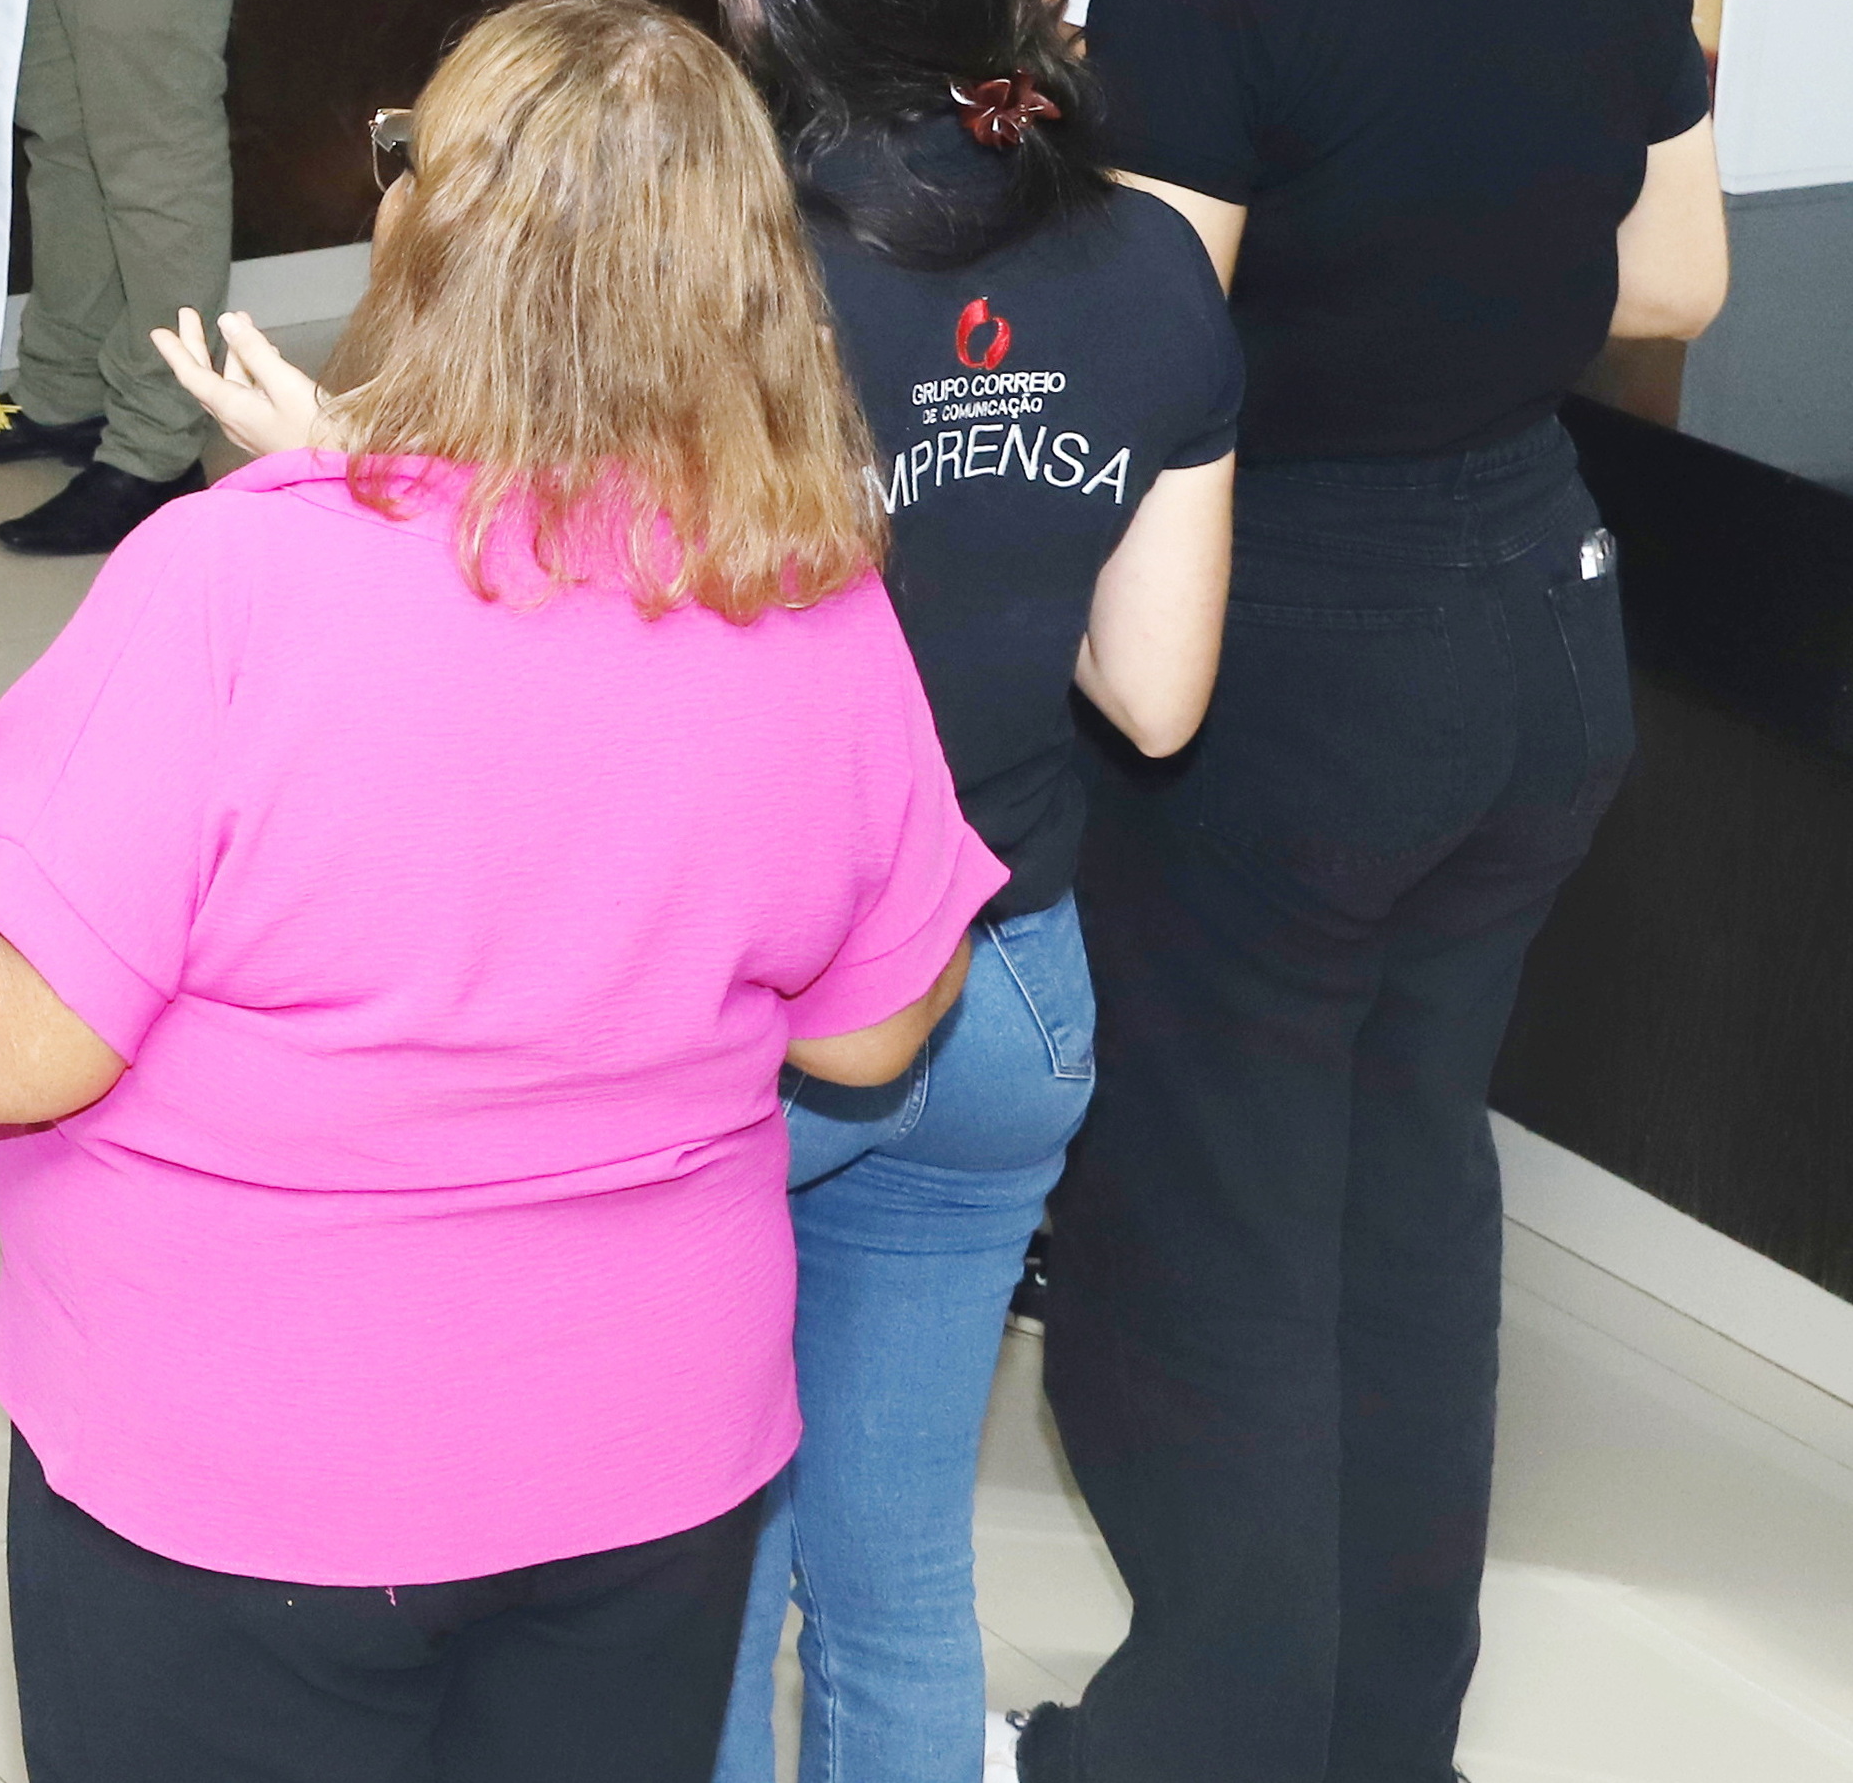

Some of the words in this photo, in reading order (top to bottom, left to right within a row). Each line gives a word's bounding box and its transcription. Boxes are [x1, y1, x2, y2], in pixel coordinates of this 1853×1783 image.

[912, 377, 969, 406] GRUPO
[971, 372, 1066, 397] CORREIO
[922, 408, 939, 424] DE
[941, 393, 1044, 419] COMUNICAÇÃO
[862, 423, 1132, 515] MPRENSA
